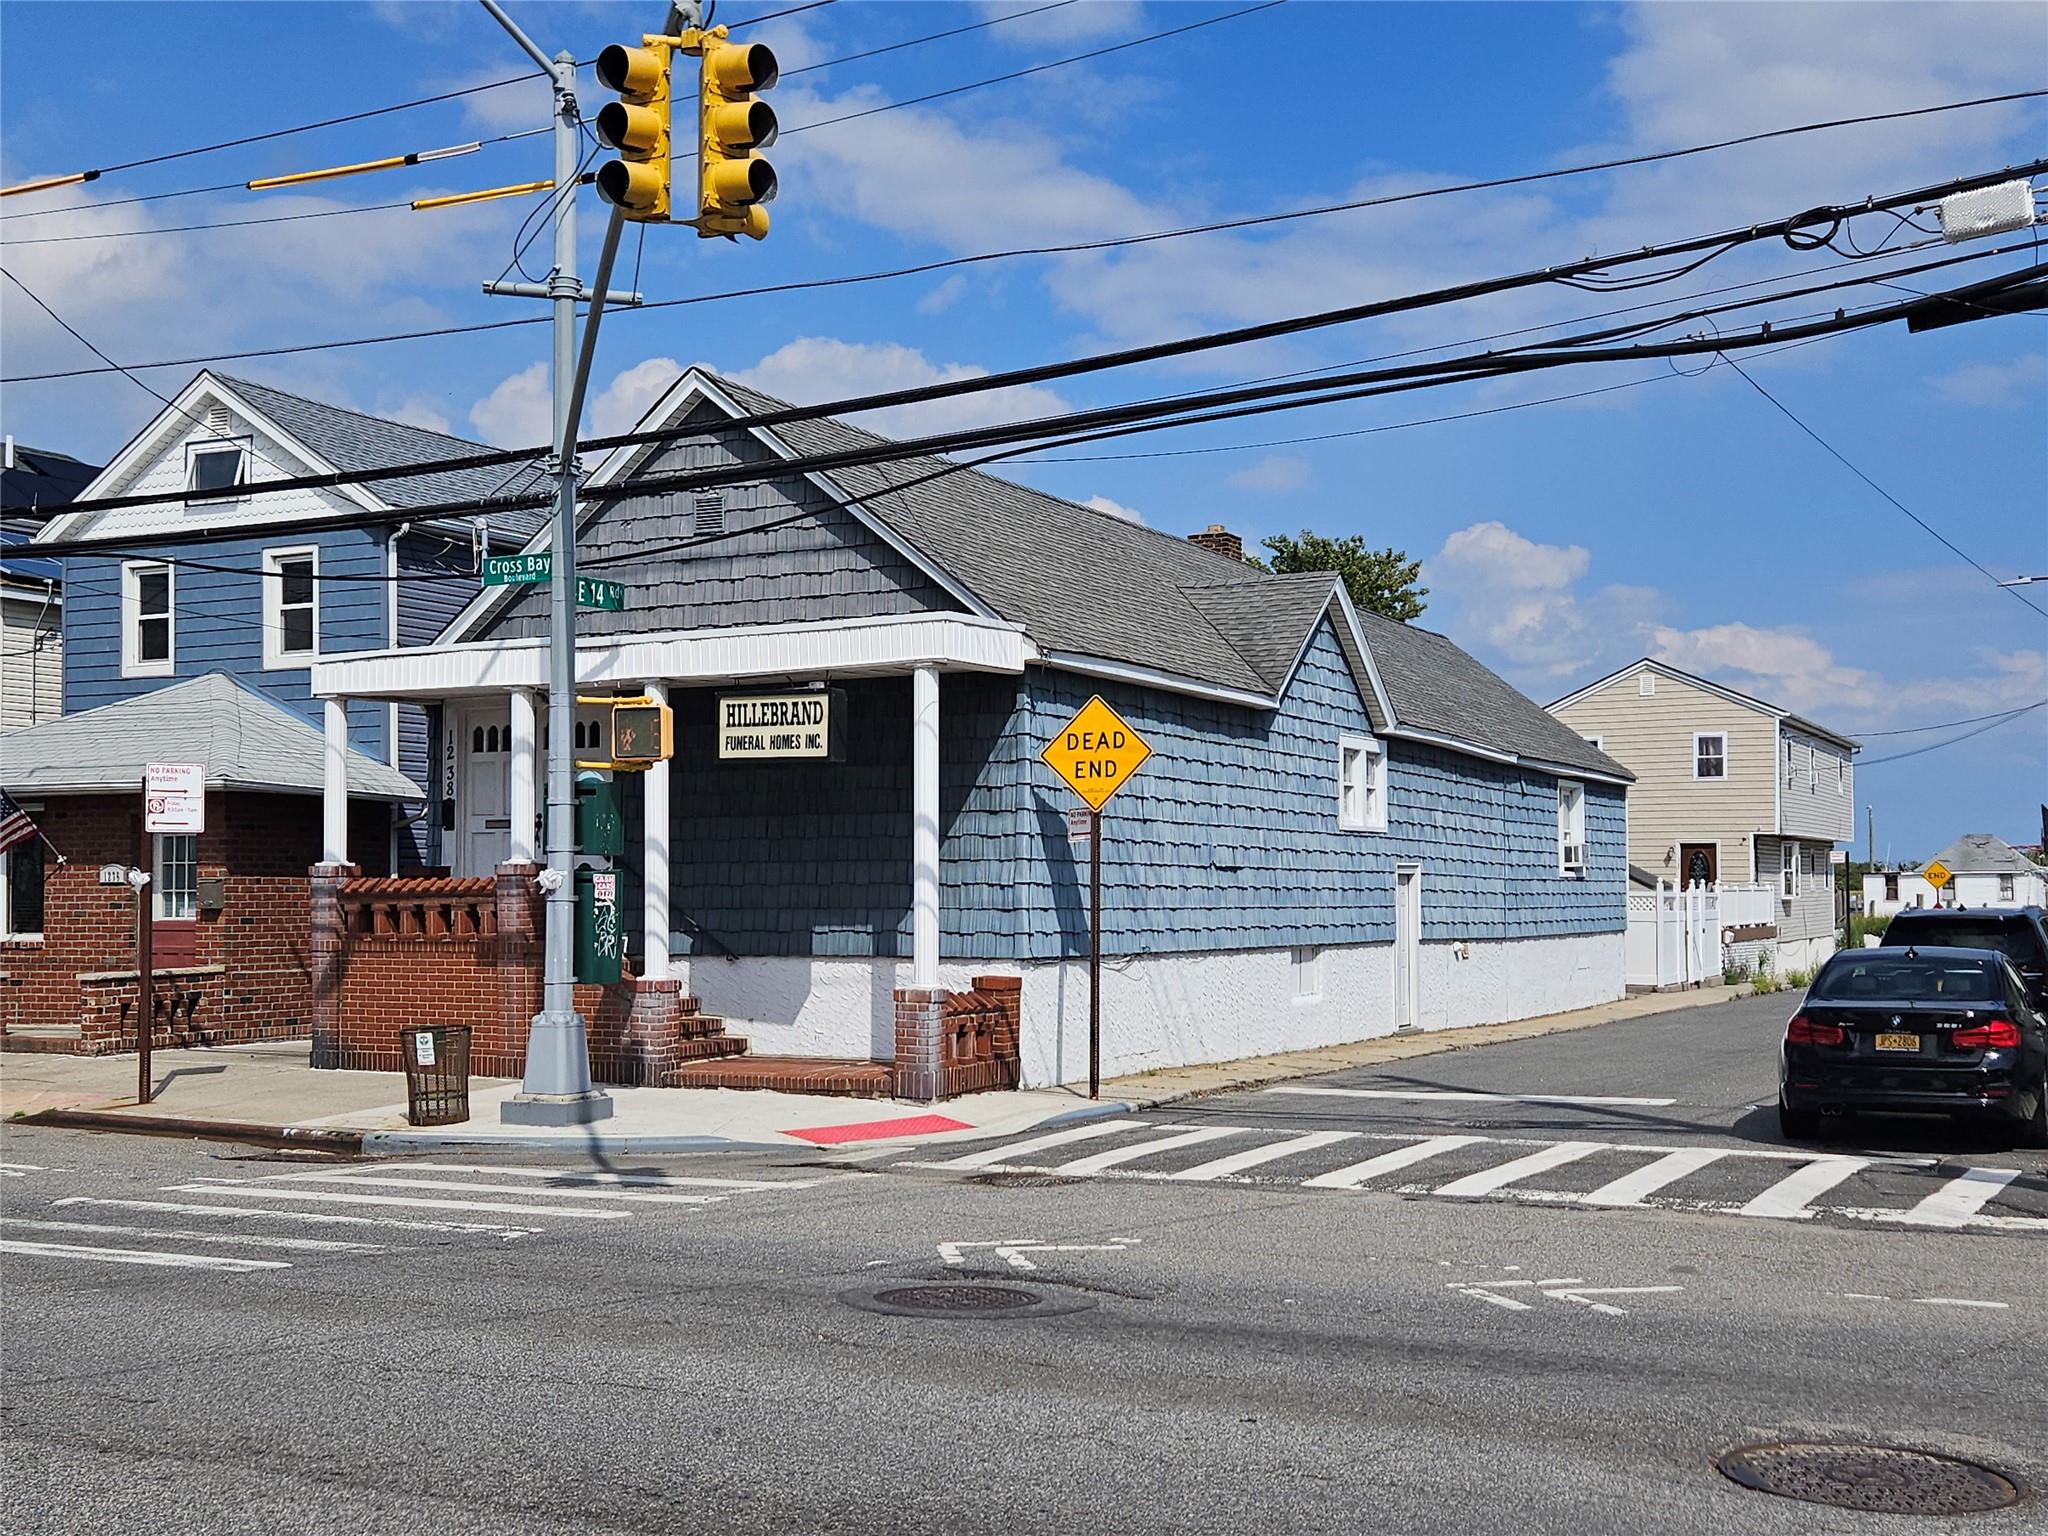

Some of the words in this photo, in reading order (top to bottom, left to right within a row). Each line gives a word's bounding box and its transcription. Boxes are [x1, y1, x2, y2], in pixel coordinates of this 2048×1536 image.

[489, 560, 523, 574] Cross
[527, 556, 551, 574] Bay
[503, 572, 537, 583] Boulevard
[578, 581, 586, 602] E
[590, 582, 604, 605] 14
[726, 701, 823, 727] HILLEBRAND
[725, 735, 766, 751] FUNERAL
[769, 734, 801, 750] HOMES
[804, 733, 823, 749] INC.
[1067, 731, 1126, 751] DEAD
[446, 729, 455, 796] 1238
[1075, 760, 1117, 779] END
[150, 775, 178, 783] Anytime
[1928, 872, 1946, 880] END
